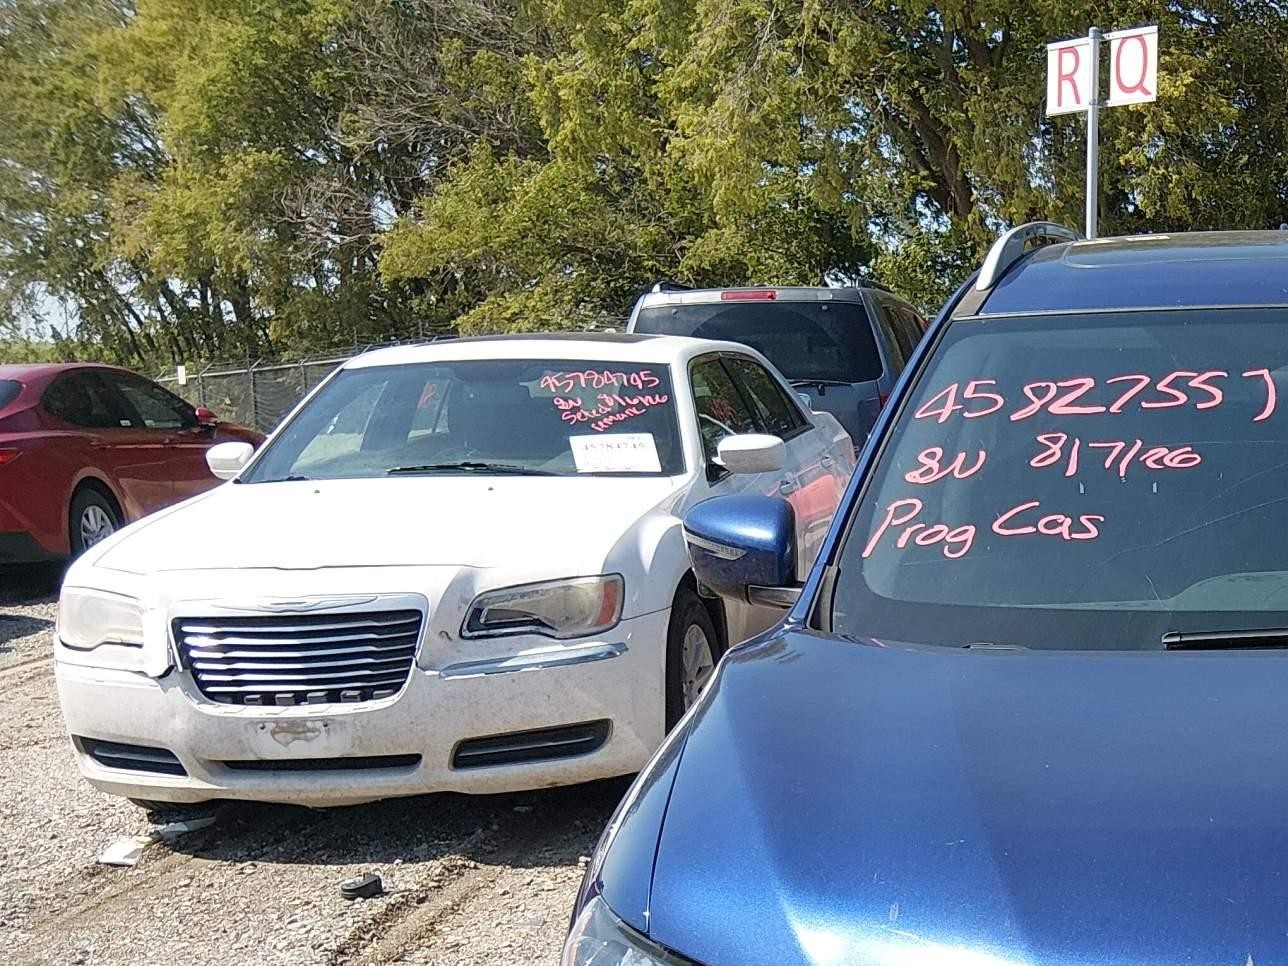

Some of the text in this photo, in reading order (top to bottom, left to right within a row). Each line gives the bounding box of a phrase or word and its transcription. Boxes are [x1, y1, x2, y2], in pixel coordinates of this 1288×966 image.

[1057, 46, 1081, 107] R
[1116, 34, 1151, 96] Q
[914, 369, 1277, 423] 45827557
[862, 499, 1105, 559] Prog Cas
